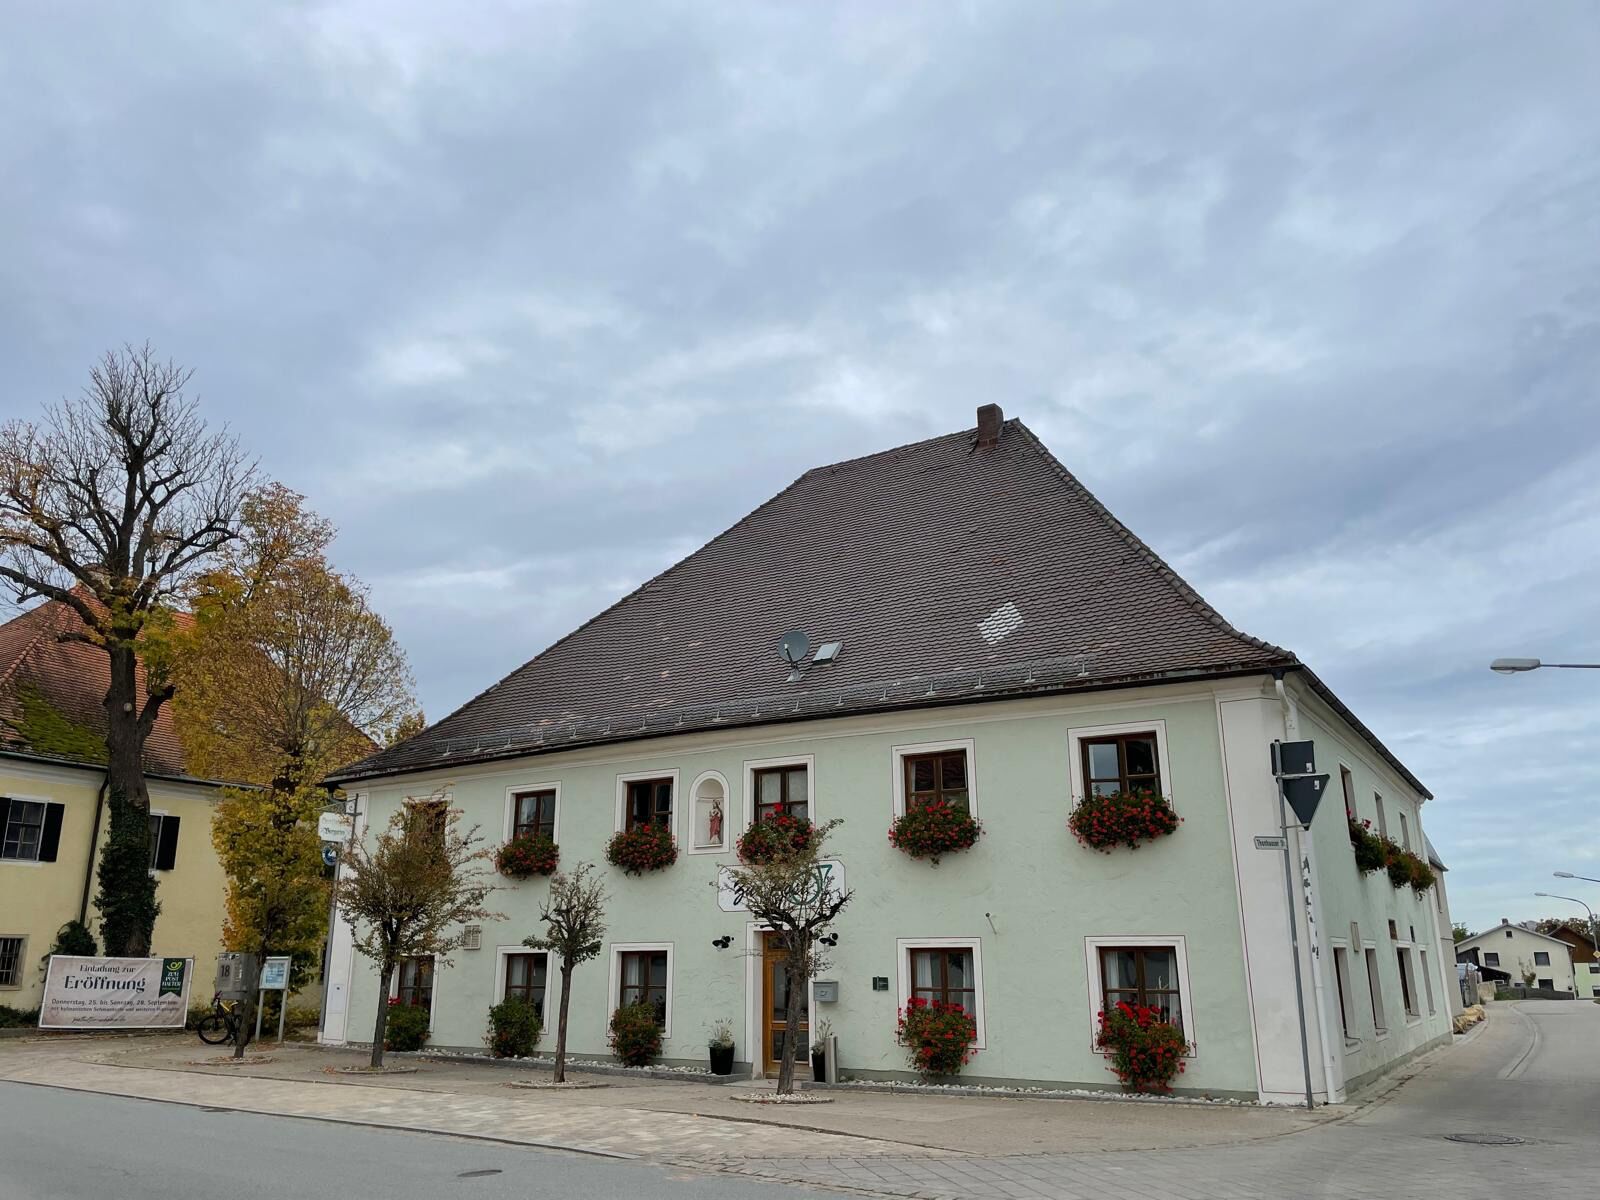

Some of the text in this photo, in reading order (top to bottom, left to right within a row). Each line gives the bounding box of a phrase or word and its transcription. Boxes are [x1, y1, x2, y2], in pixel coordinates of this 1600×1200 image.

[80, 964, 120, 974] Einladung
[220, 964, 231, 977] 18
[64, 975, 146, 994] Eröffnung
